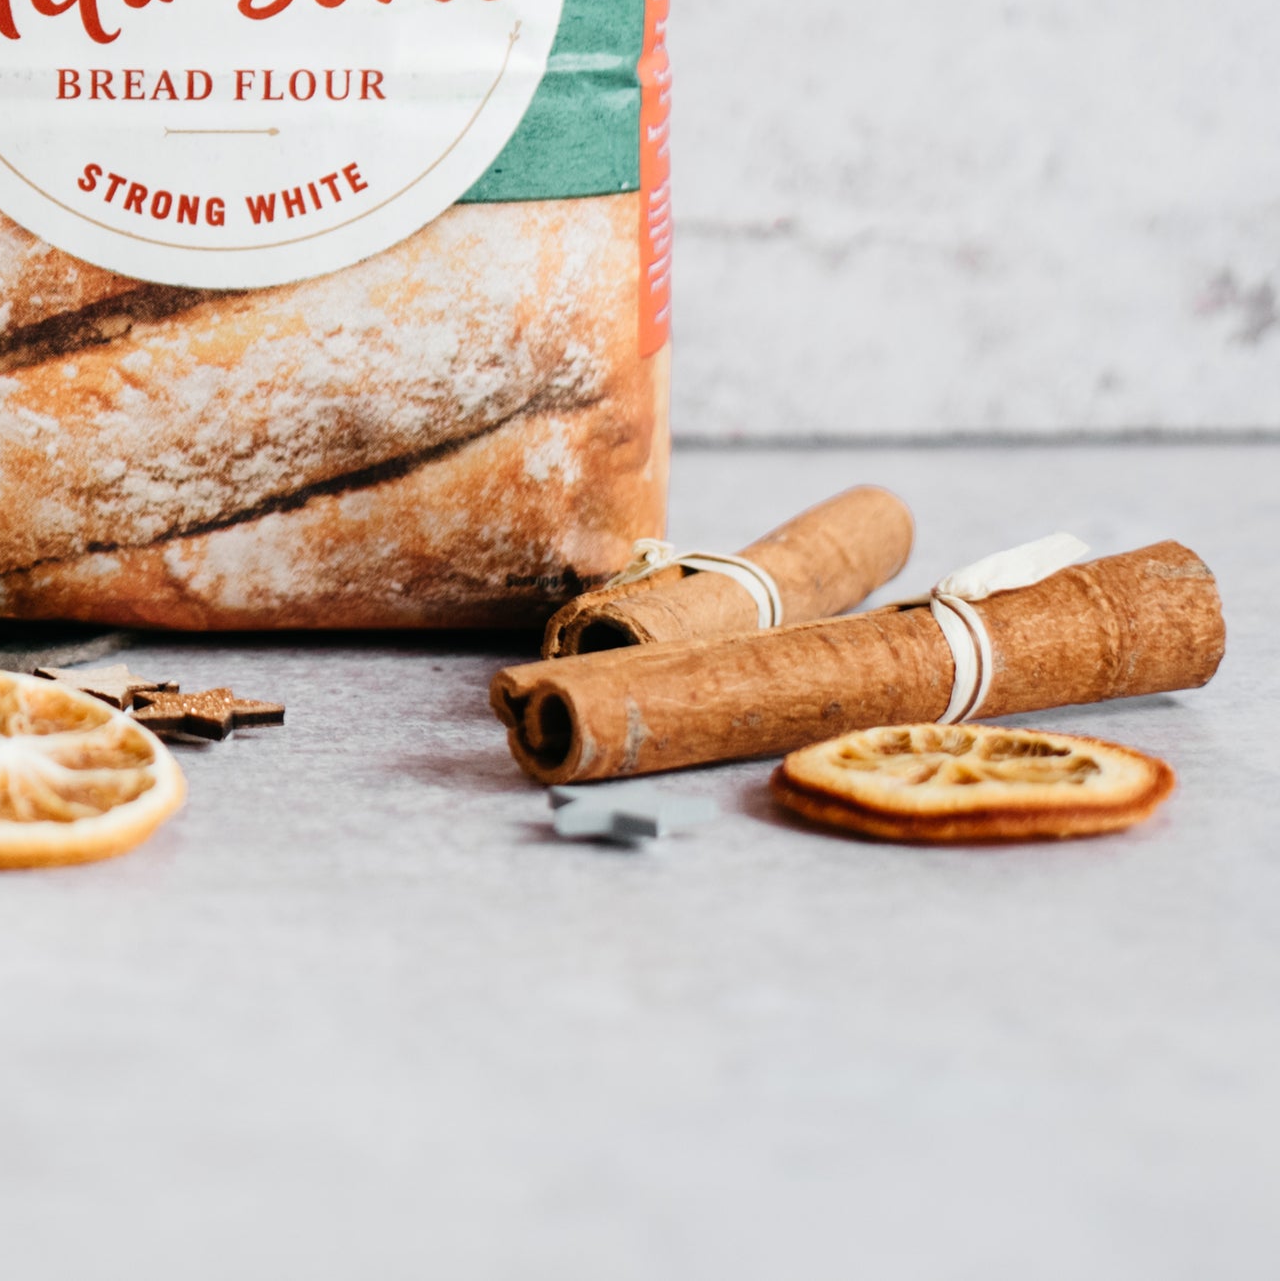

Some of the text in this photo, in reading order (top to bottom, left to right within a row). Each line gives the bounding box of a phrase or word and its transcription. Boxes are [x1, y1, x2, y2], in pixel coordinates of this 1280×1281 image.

[56, 69, 387, 102] BREAD FLOUR
[77, 162, 369, 226] STRONG WHITE
